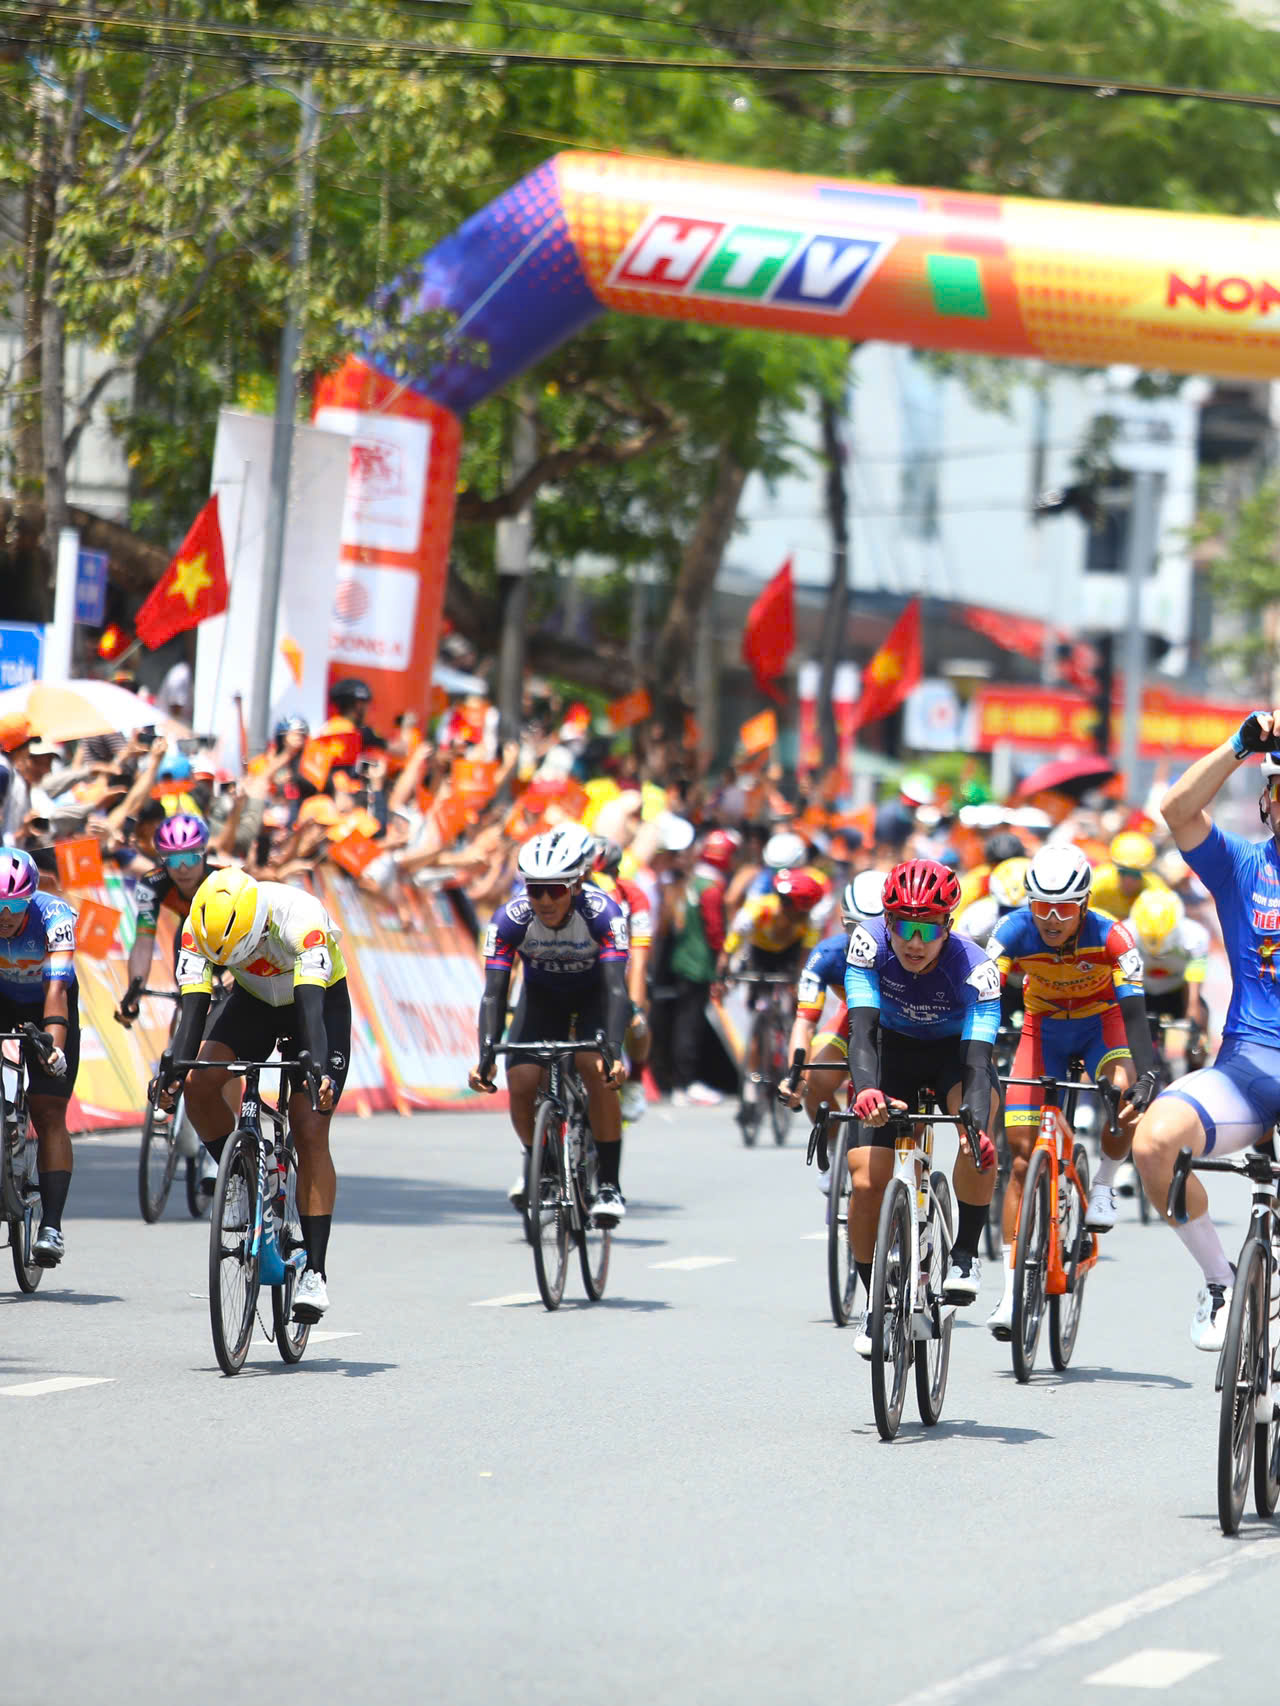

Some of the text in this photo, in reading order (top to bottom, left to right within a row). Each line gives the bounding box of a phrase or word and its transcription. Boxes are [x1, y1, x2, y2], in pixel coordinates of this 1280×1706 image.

[626, 224, 870, 298] HTV
[179, 958, 189, 976] 1
[319, 952, 326, 970] 1
[976, 967, 999, 990] 73
